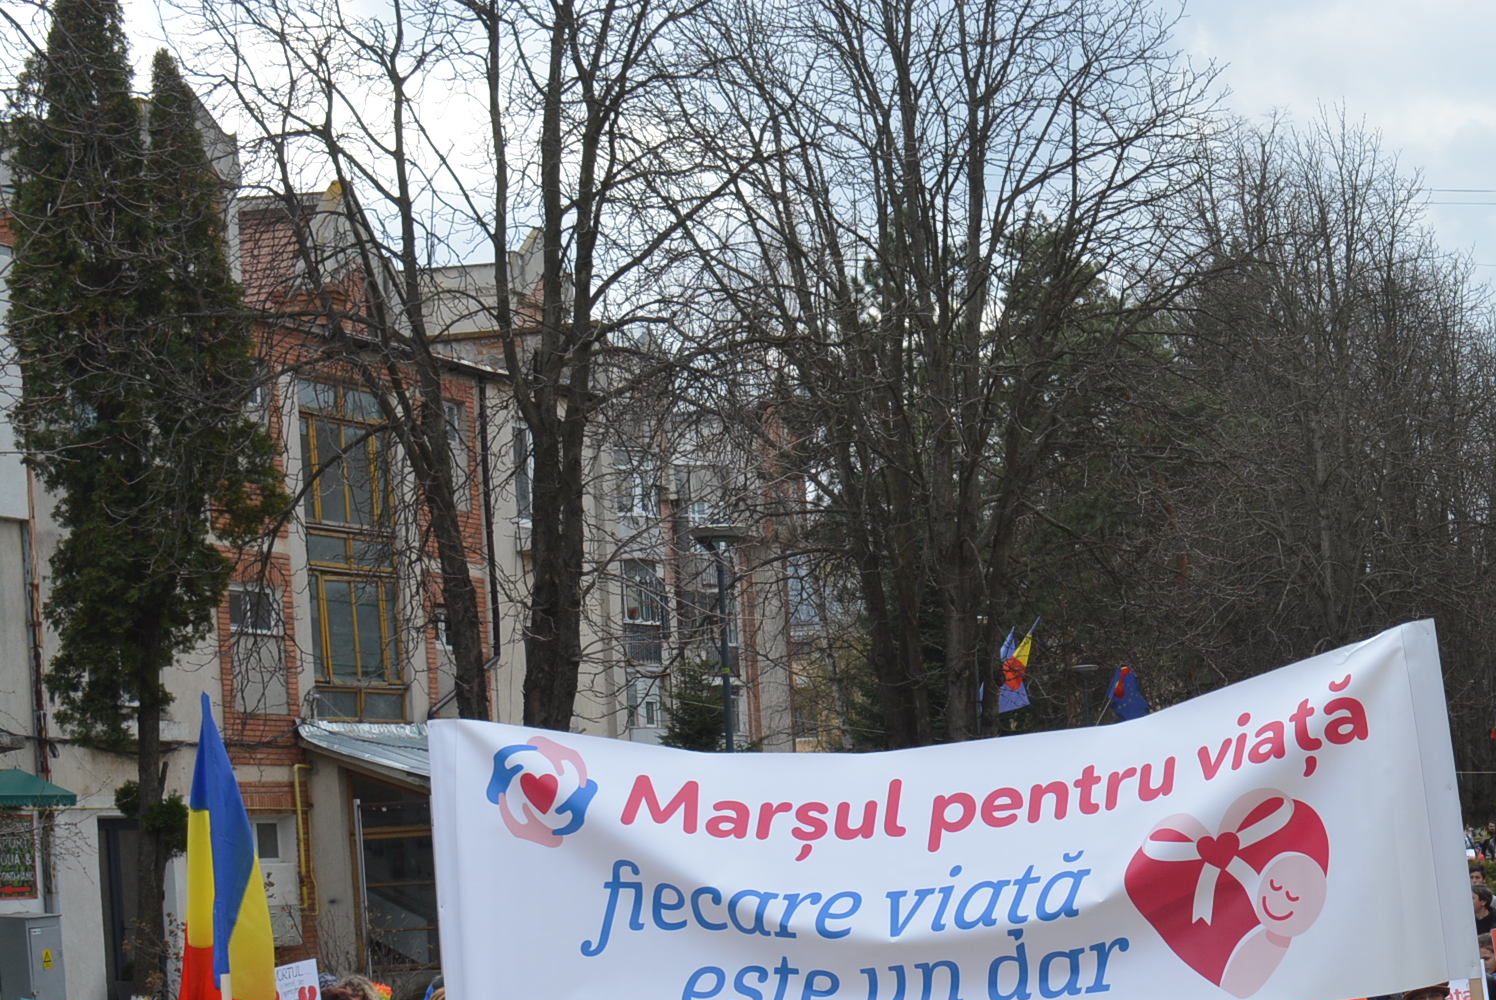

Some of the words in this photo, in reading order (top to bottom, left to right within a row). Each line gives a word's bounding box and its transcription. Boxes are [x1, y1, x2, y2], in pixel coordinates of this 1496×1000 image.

[620, 774, 907, 862] Marșul
[927, 755, 1176, 853] pentru
[1197, 673, 1369, 777] viață
[580, 859, 863, 957] fiecare
[885, 850, 1091, 941] viață
